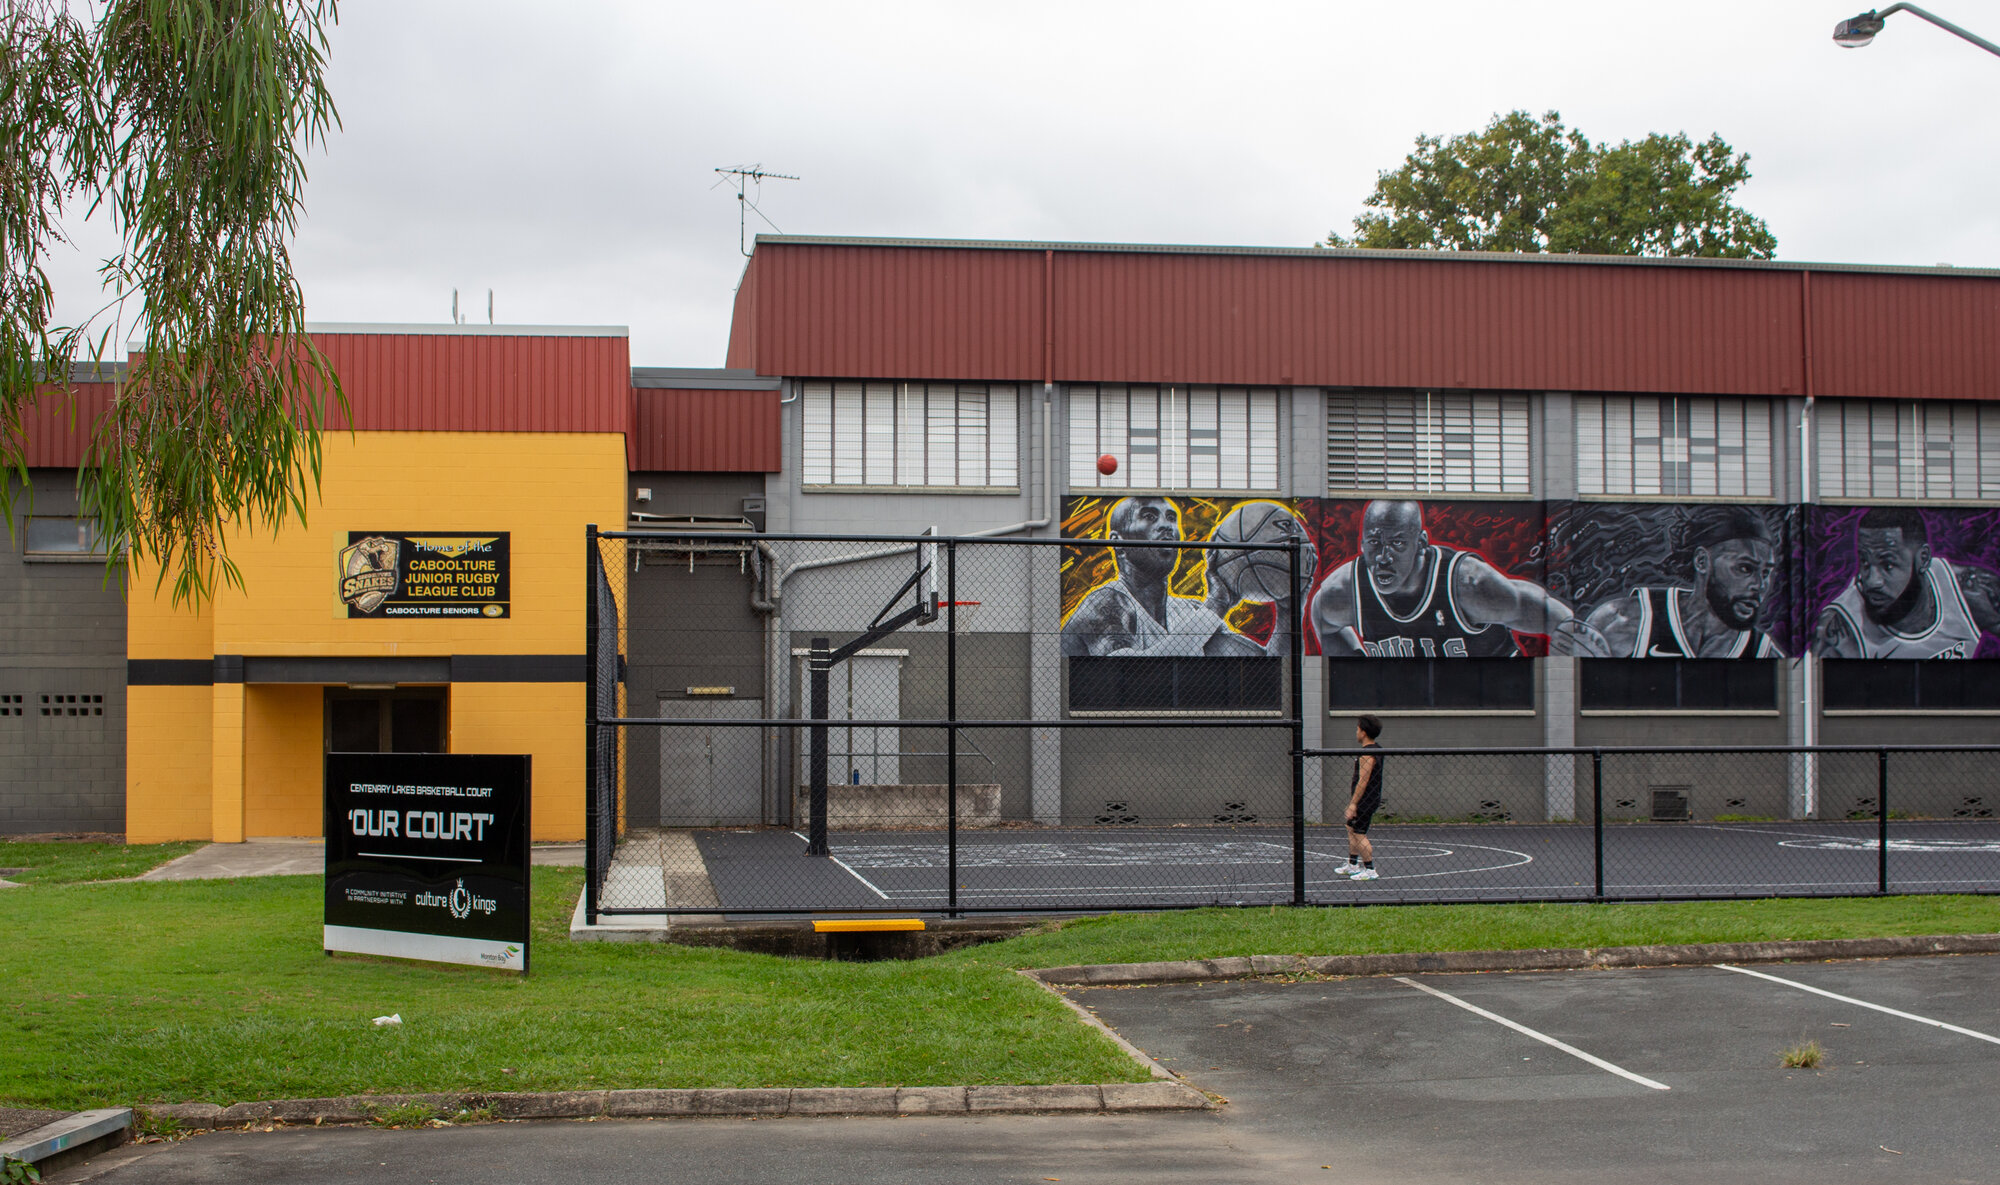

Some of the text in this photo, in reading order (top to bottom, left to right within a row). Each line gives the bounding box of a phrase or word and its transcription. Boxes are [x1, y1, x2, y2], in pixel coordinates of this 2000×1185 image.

[415, 540, 492, 555] Home of the
[409, 560, 496, 571] CABOOLTURE
[405, 573, 500, 584] JUNIOR RUGBY
[343, 576, 395, 598] SNAKES
[408, 586, 496, 597] LEAGUE CLUB
[386, 607, 479, 615] CABOOLTURE SENIORS
[350, 783, 493, 798] CENTENARY LAKES BASKETBALL COURT
[350, 889, 380, 897] COMMUNITY
[353, 896, 389, 904] PARTNERSHIP
[415, 891, 448, 908] culture
[472, 894, 497, 915] kings
